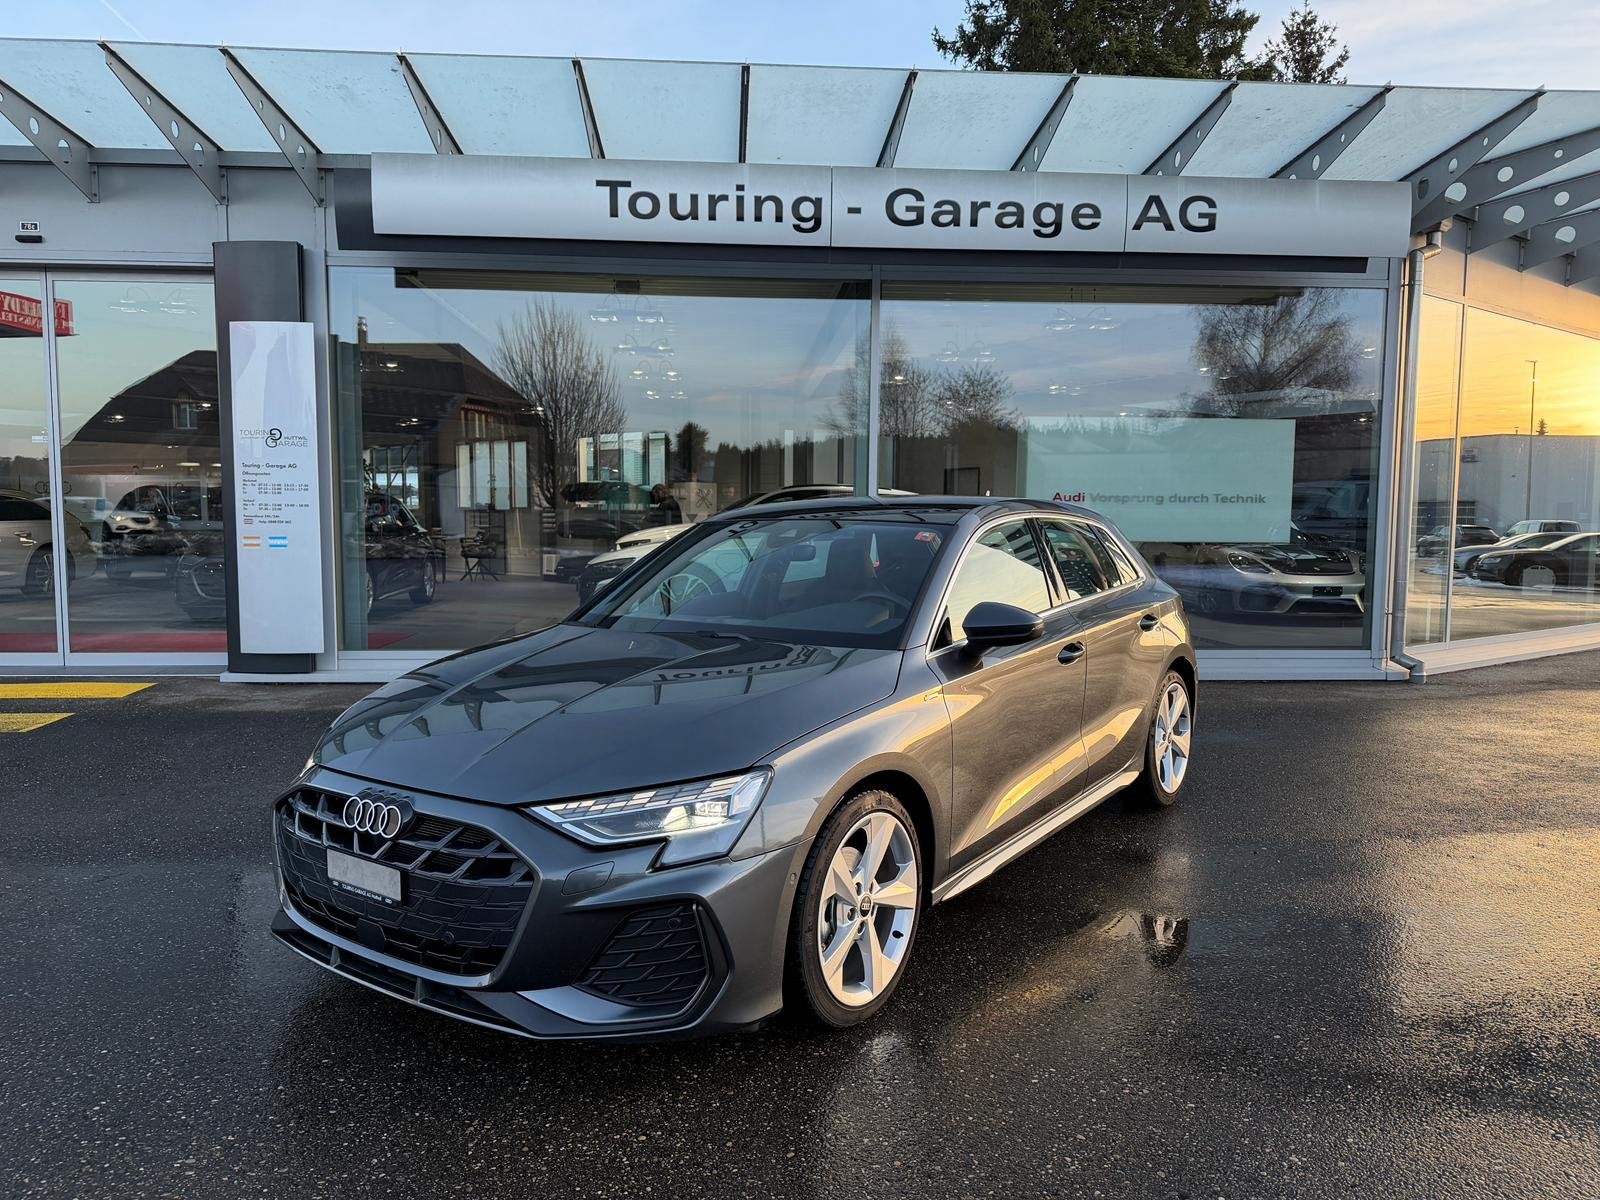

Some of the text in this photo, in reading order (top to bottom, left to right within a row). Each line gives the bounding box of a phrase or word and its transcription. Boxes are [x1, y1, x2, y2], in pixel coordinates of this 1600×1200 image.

[596, 180, 822, 233] Touring
[886, 188, 1101, 238] Garage
[1132, 195, 1217, 232] AG
[1052, 491, 1267, 505] Audi Vorsprung durch Technik
